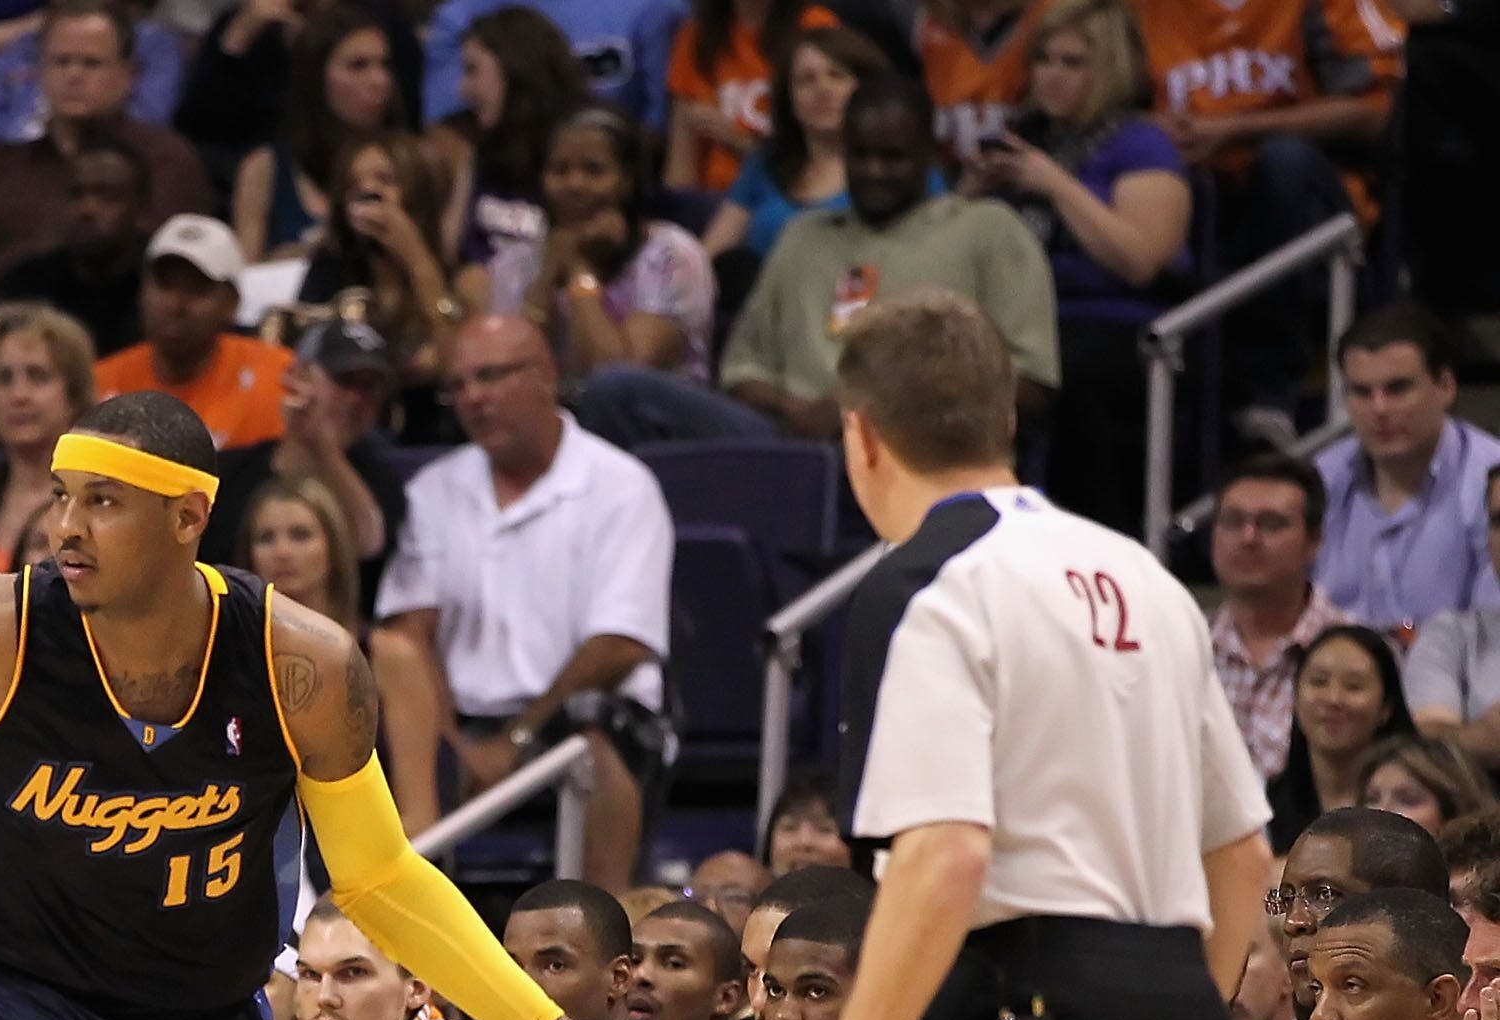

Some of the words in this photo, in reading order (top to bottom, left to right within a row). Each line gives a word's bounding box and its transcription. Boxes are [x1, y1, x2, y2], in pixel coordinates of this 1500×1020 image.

[1166, 48, 1296, 113] PHX
[1065, 569, 1141, 653] 22
[9, 763, 242, 855] Nuggets
[161, 832, 245, 908] 15
